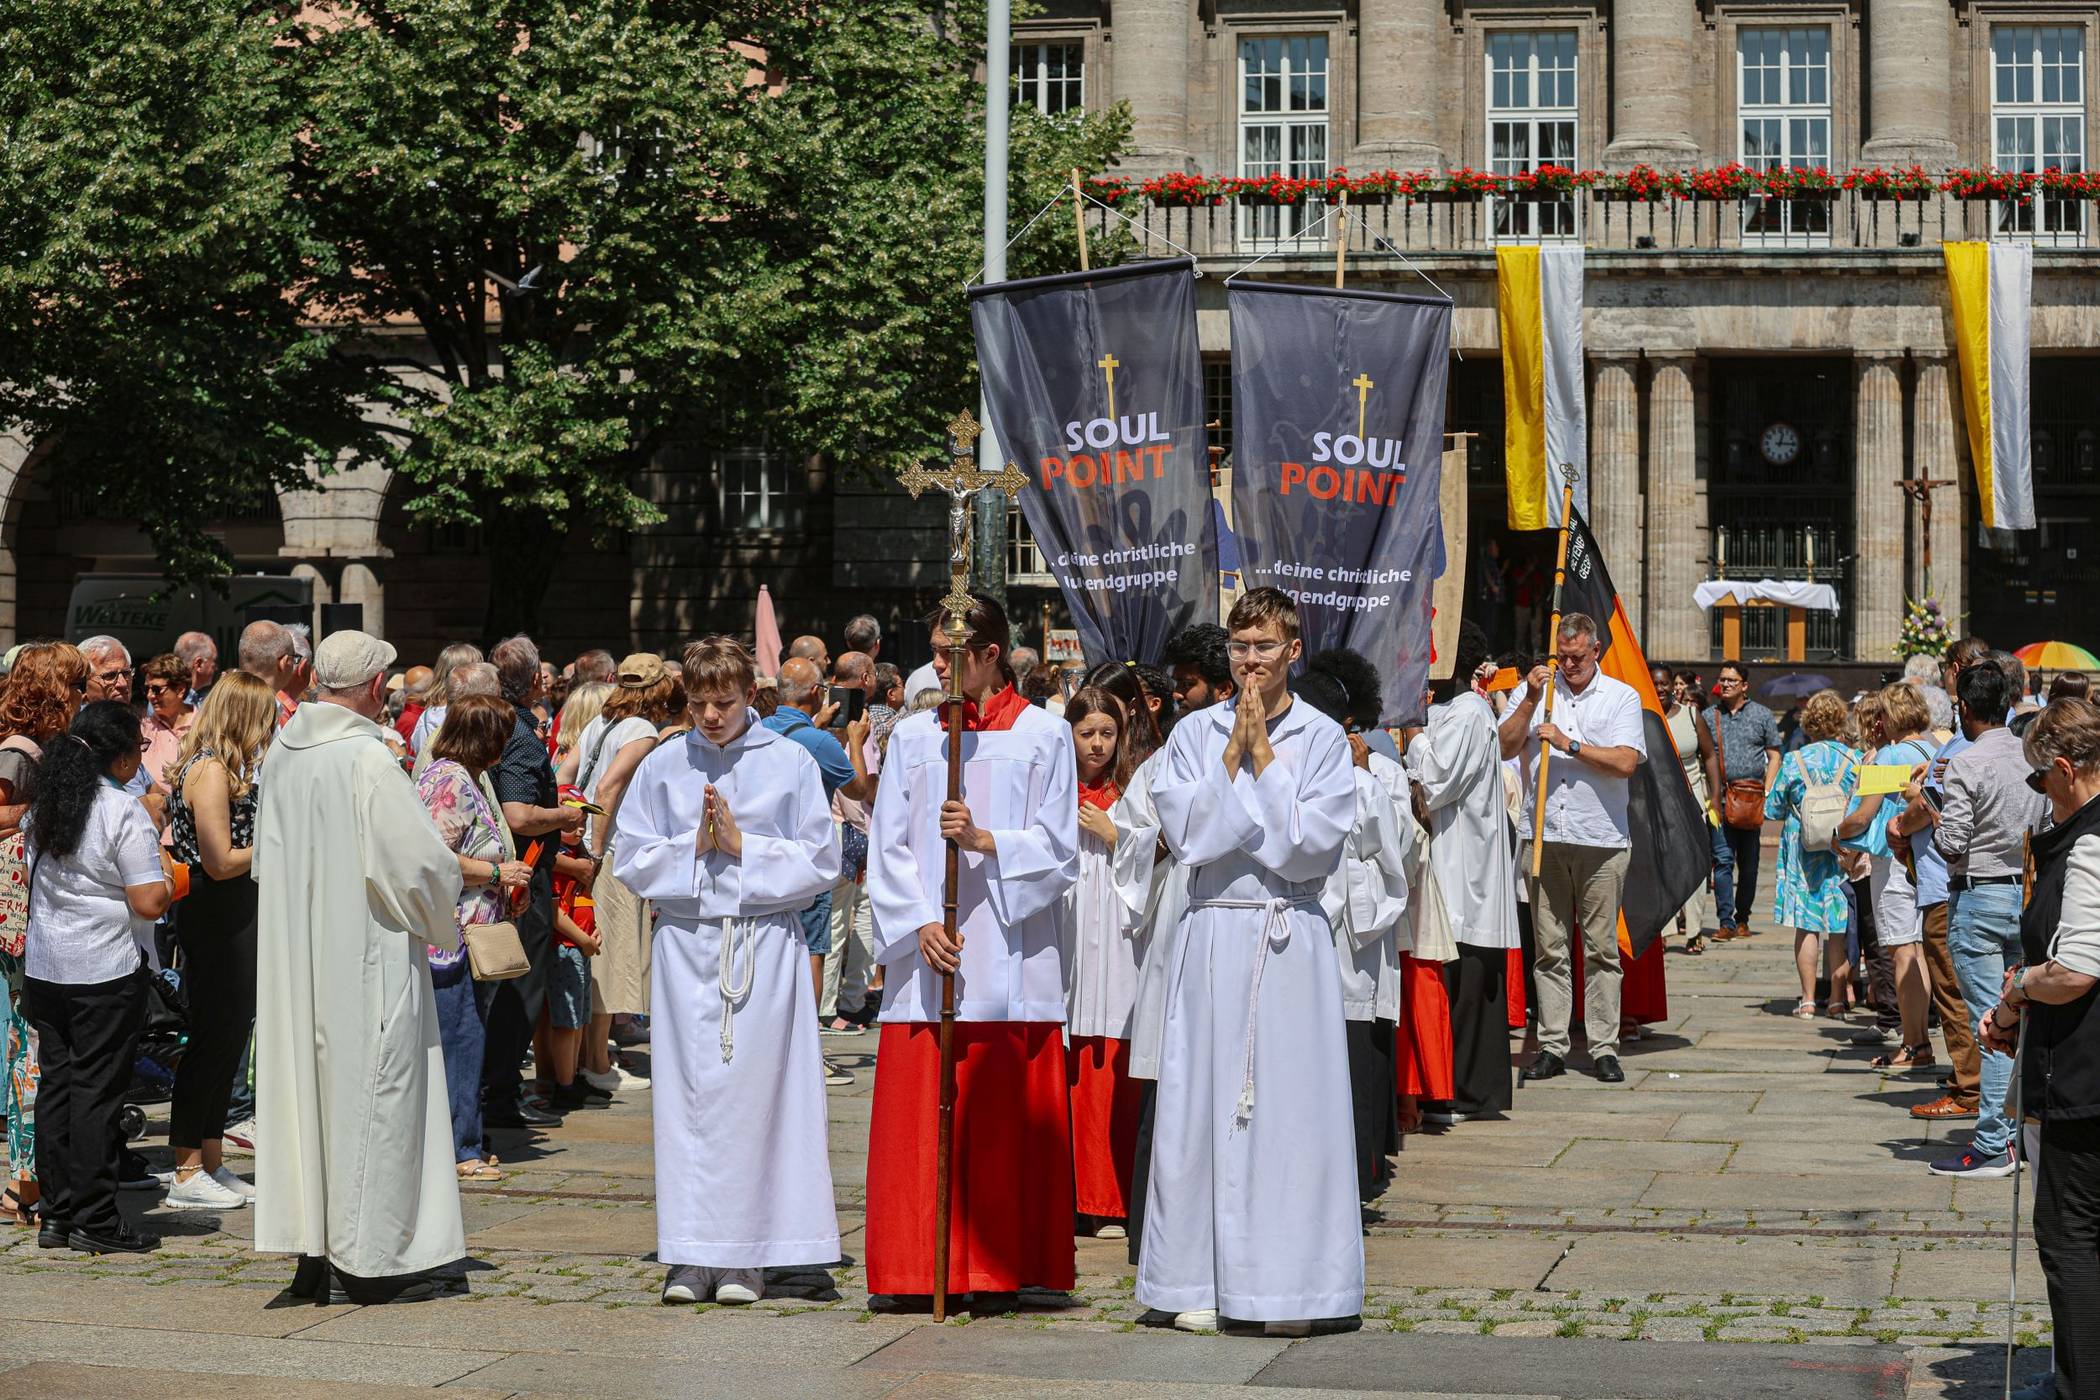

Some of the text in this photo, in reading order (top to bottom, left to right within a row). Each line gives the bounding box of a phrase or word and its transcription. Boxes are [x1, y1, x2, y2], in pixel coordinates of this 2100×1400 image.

[1066, 412, 1169, 451] SOUL
[1040, 444, 1173, 490] POINT
[1312, 432, 1406, 471] SOUL
[1280, 463, 1406, 507] POINT
[1102, 542, 1195, 565] christliche
[1328, 567, 1411, 584] christliche
[75, 605, 168, 626] WELTEKE
